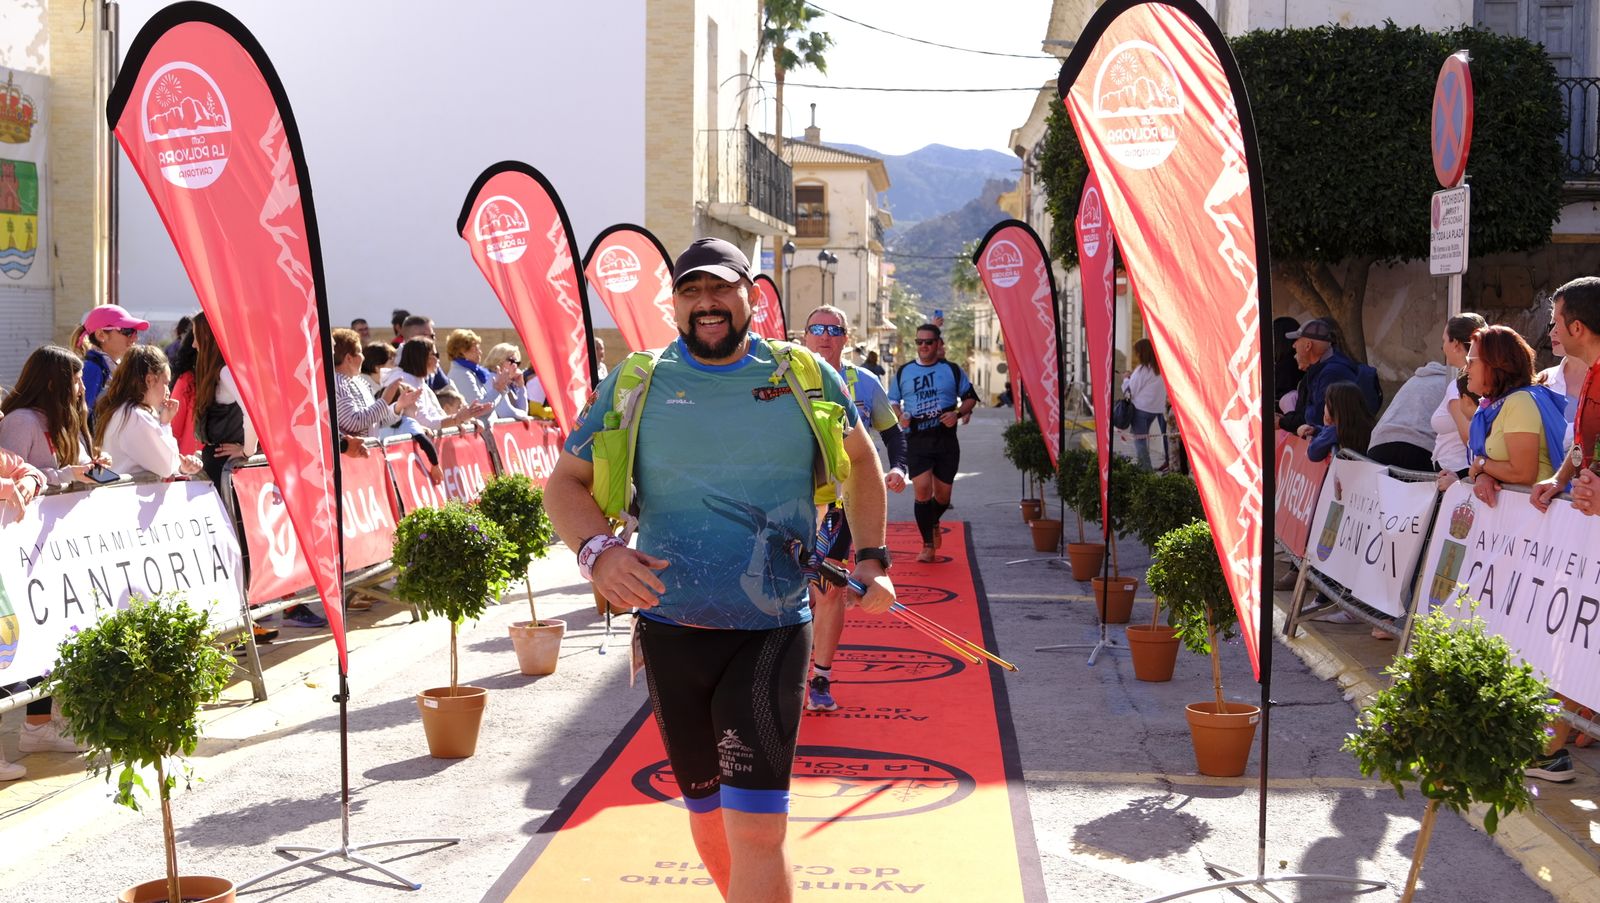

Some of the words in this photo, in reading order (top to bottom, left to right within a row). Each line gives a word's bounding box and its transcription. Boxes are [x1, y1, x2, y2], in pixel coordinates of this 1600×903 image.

[1436, 230, 1446, 241] TODA
[1452, 228, 1464, 239] PLAZA
[912, 370, 936, 393] EAT
[915, 388, 938, 402] TRAIN
[342, 485, 388, 538] OLIA
[1284, 469, 1316, 526] VEOLIA
[19, 522, 185, 568] AYUNTAMIENTO
[190, 516, 216, 537] DE
[27, 544, 229, 625] CANTORIA
[1460, 561, 1600, 655] CANTOR
[884, 764, 930, 772] LA
[848, 865, 901, 878] de
